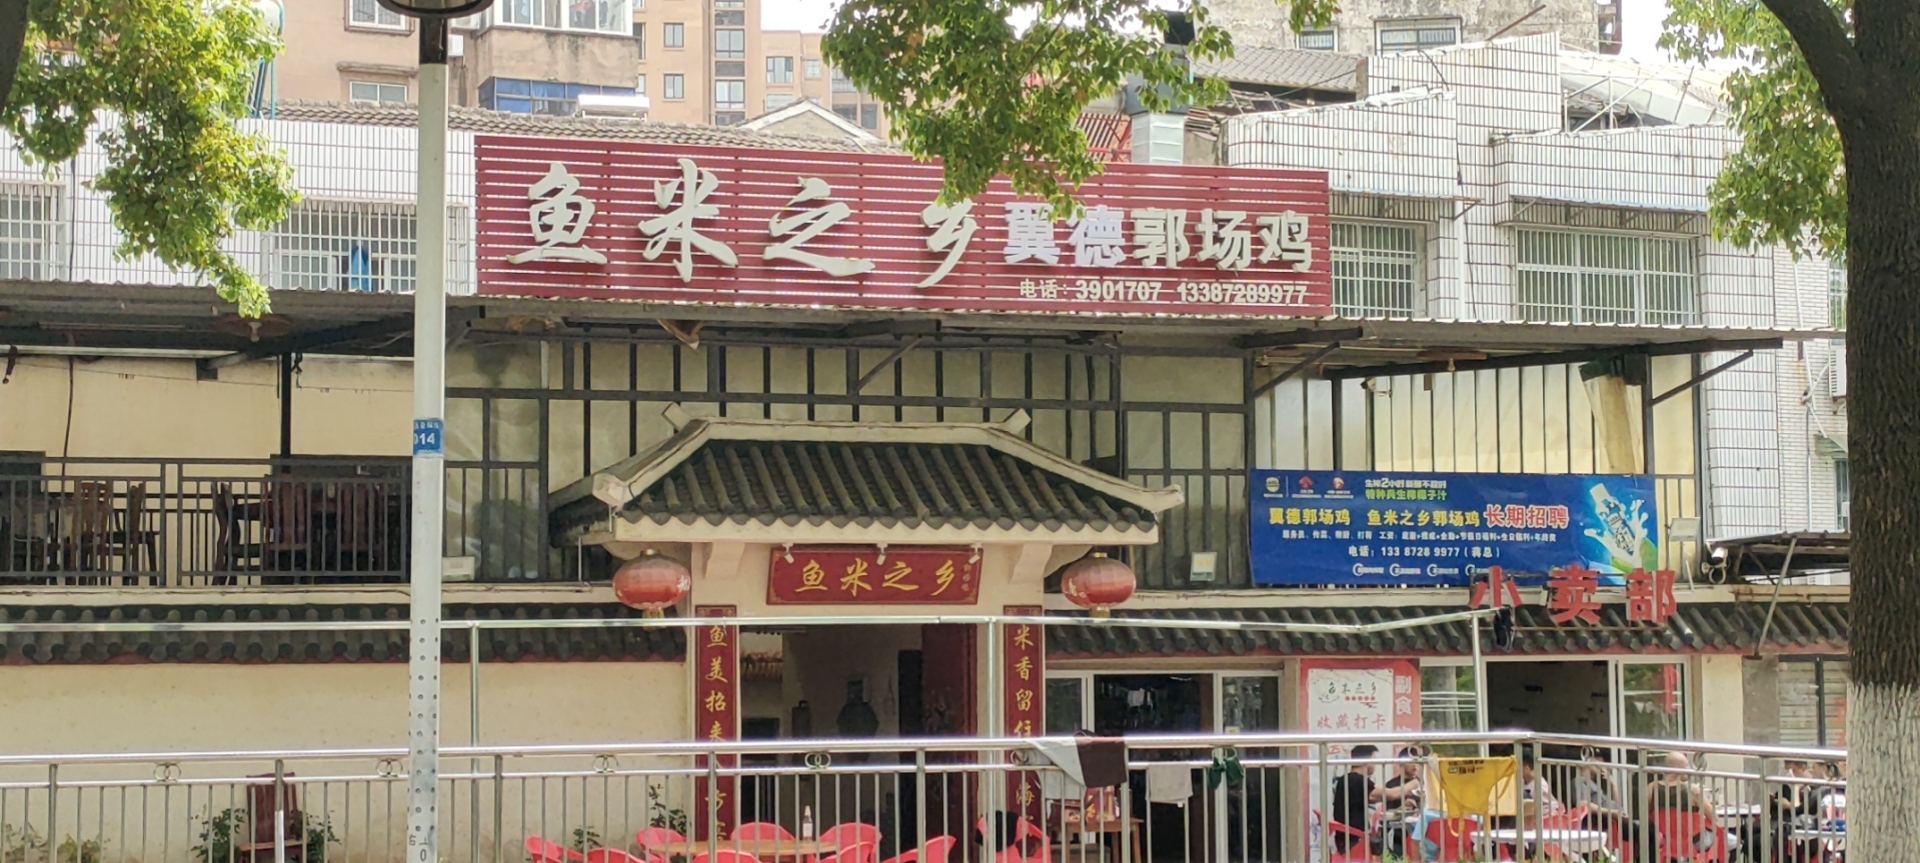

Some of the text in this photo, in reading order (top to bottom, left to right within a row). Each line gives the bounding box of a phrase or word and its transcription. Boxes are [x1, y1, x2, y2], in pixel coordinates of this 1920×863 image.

[506, 158, 1312, 288] 鱼米之乡 翼德郭场鸡
[1075, 279, 1163, 301] 3901707
[1177, 282, 1308, 304] 13387289977
[1269, 504, 1569, 528] 翼德郭场鸡 鱼米之乡郭场鸡 长期招聘
[1381, 546, 1400, 557] 133
[1404, 546, 1431, 557] 8728
[1434, 546, 1460, 558] 9977
[795, 557, 956, 597] 鱼米之乡
[1468, 564, 1678, 624] 小卖部
[1317, 713, 1386, 731] 收藏打卡
